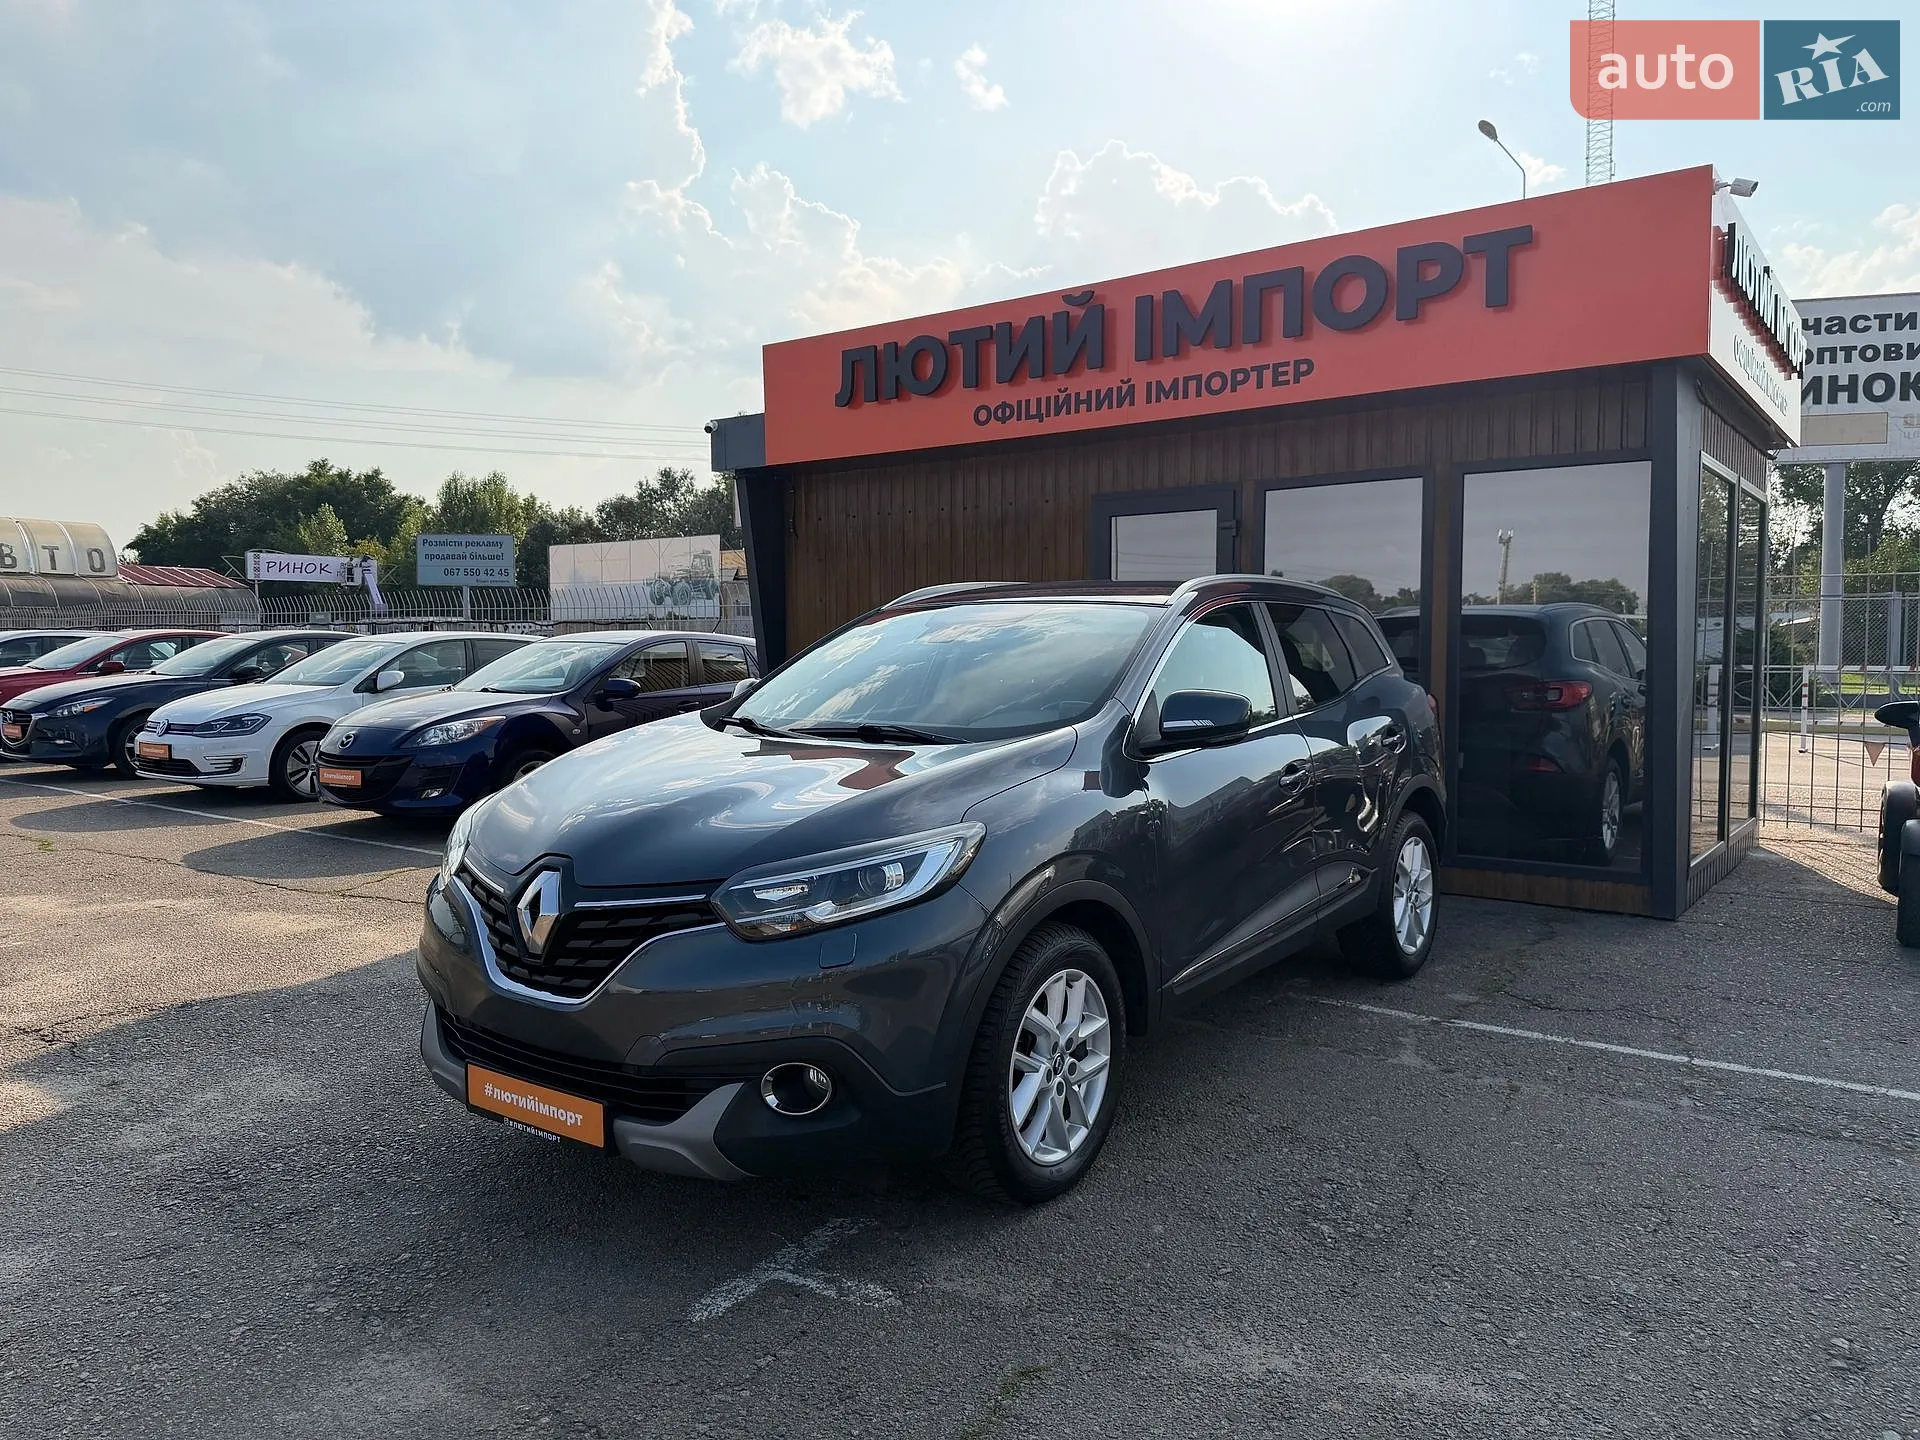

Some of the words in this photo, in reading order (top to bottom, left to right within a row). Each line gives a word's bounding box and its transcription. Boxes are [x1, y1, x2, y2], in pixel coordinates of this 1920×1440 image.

[835, 290, 1104, 407] ЛЮТИЙ
[1134, 225, 1533, 362] ІМПОРТ
[973, 378, 1136, 426] ОФІЦІЙНИЙ
[1145, 358, 1315, 405] ІМПОРТЕР
[422, 539, 463, 547] Розмісти
[465, 540, 504, 549] рекламу
[424, 552, 467, 561] продавай
[469, 552, 504, 561] більше!
[266, 561, 332, 575] РИНОК
[443, 568, 461, 577] 067
[463, 568, 481, 577] 550
[483, 568, 495, 577] 42
[497, 568, 509, 577] 45
[484, 1082, 583, 1126] #лютийімпорт
